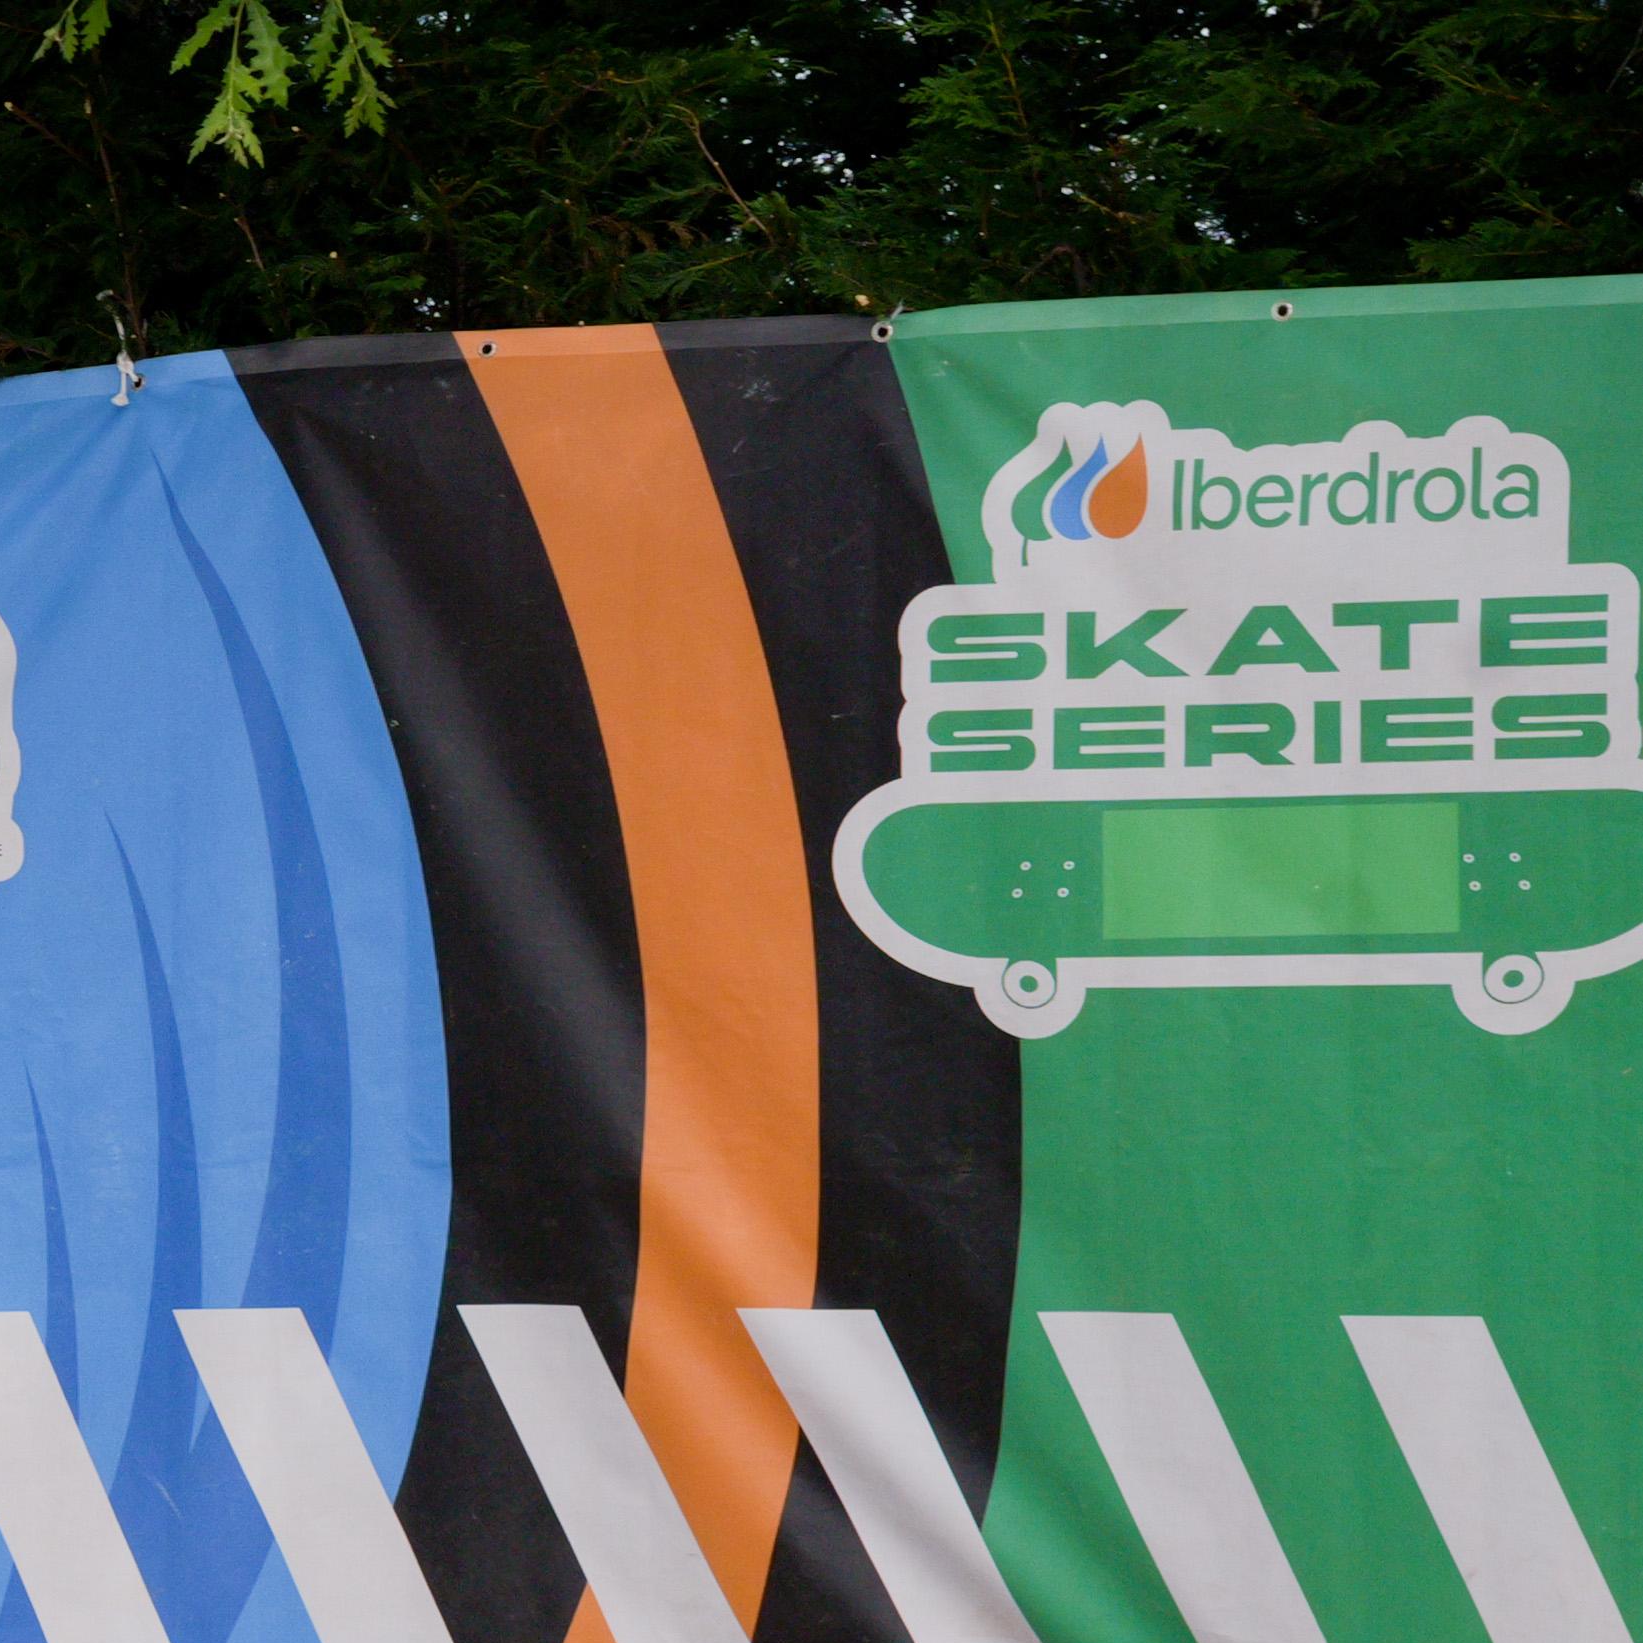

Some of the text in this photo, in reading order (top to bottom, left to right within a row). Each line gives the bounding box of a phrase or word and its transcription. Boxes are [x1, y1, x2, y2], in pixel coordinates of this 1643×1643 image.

[1172, 446, 1539, 531] Iberdrola
[927, 594, 1609, 683] SKATE
[927, 693, 1611, 773] SERIES
